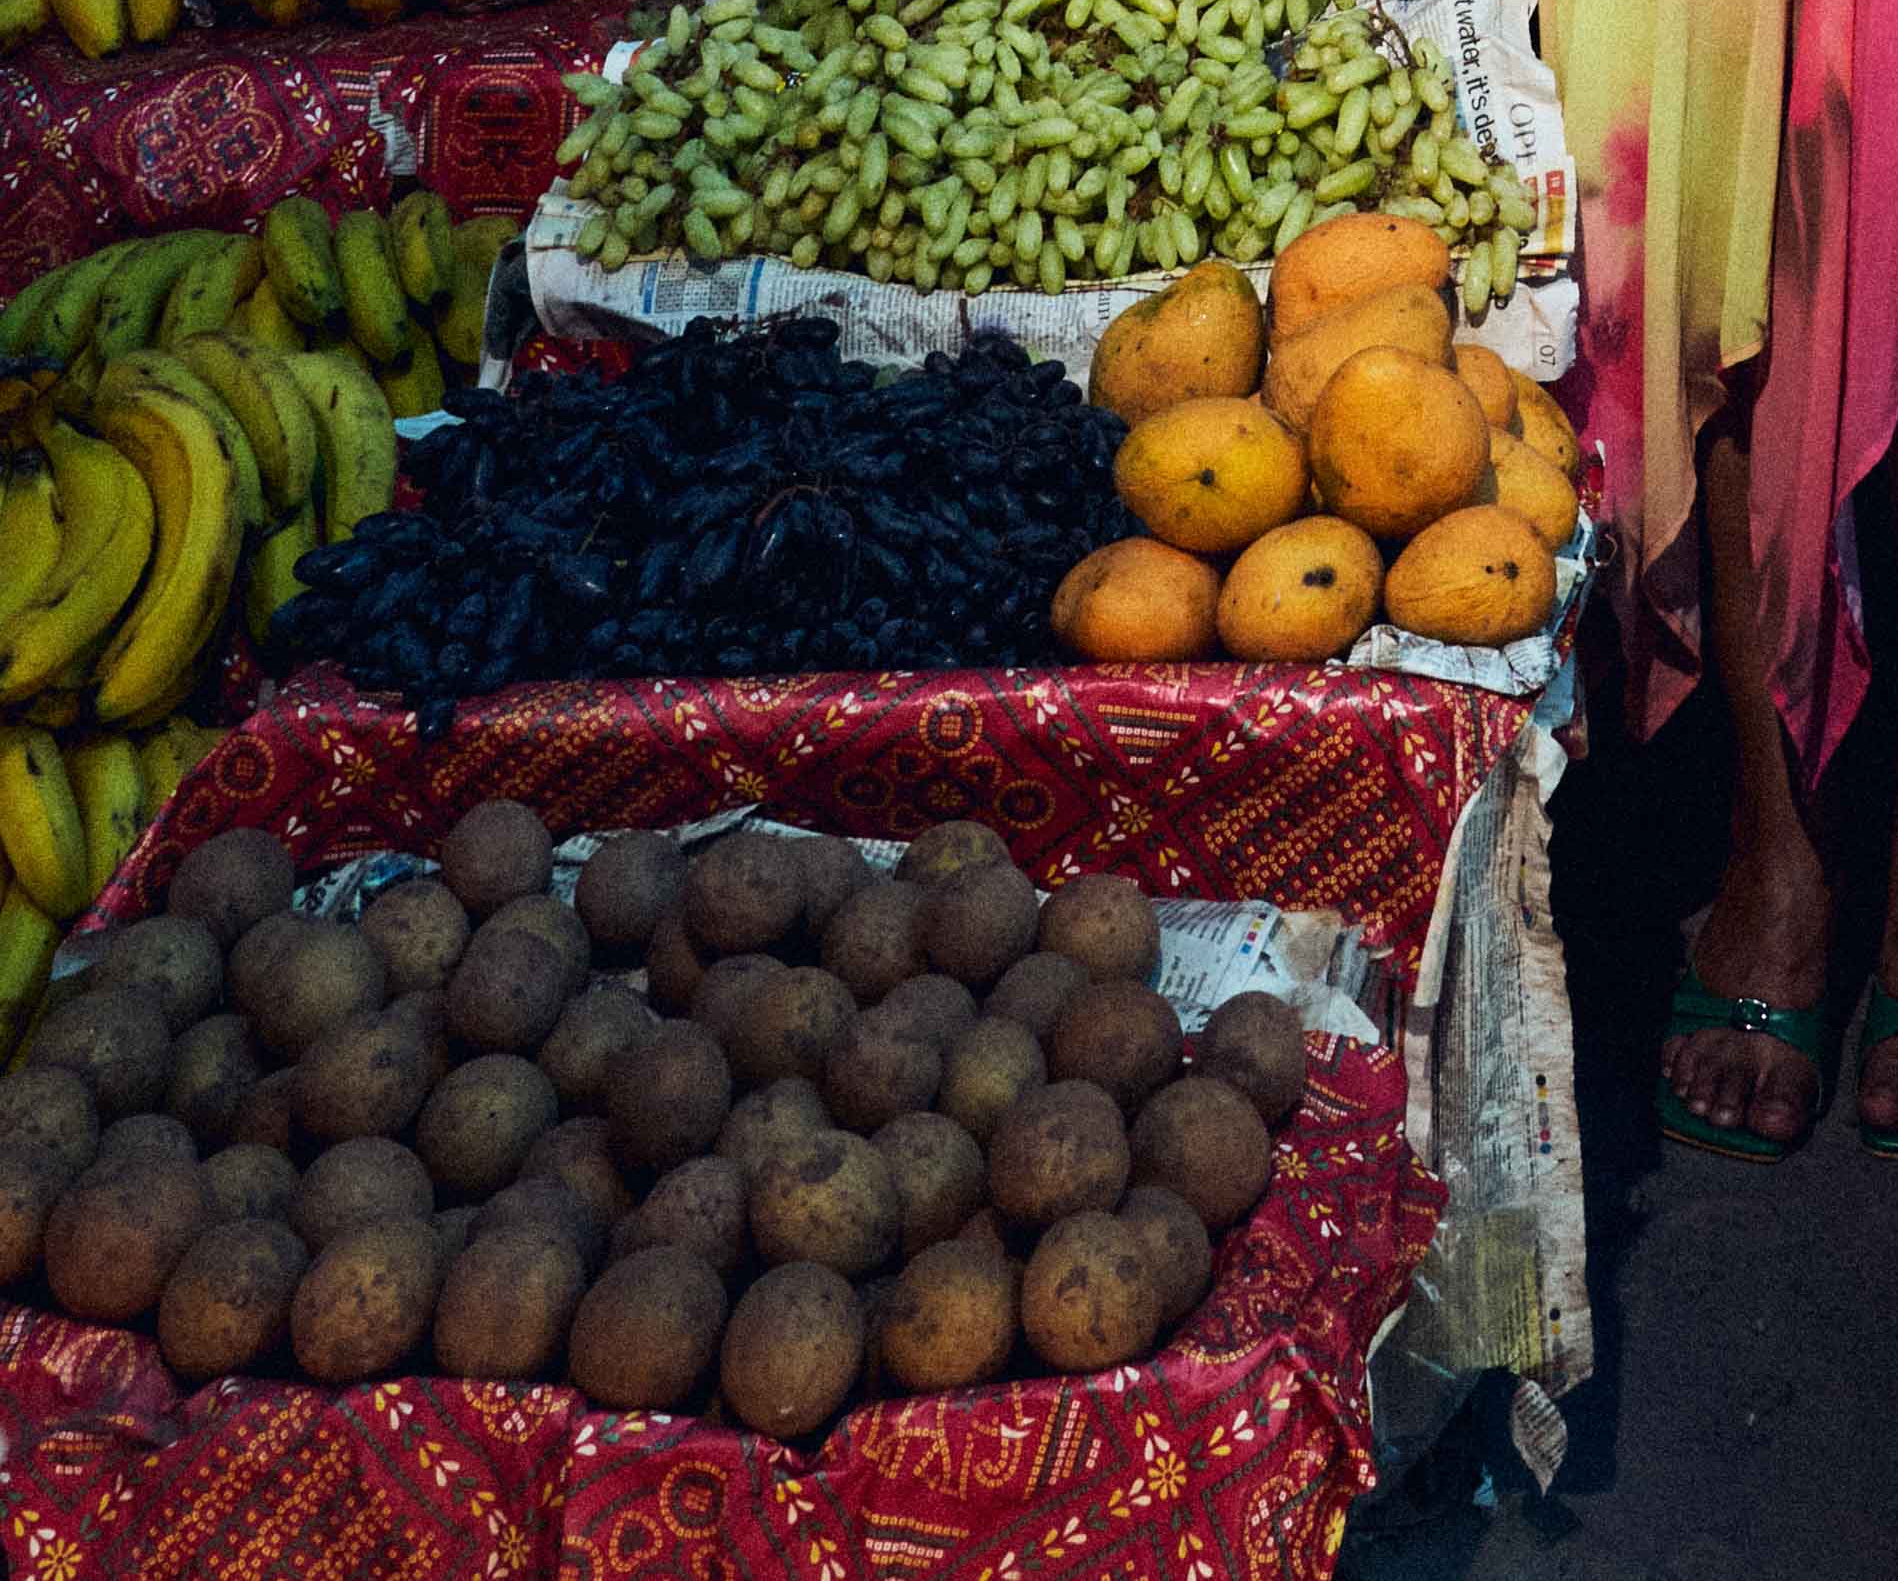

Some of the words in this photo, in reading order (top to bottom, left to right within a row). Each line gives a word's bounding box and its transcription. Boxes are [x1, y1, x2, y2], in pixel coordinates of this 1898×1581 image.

[1453, 9, 1486, 75] water,
[1466, 77, 1494, 112] it's
[1539, 344, 1556, 366] 07
